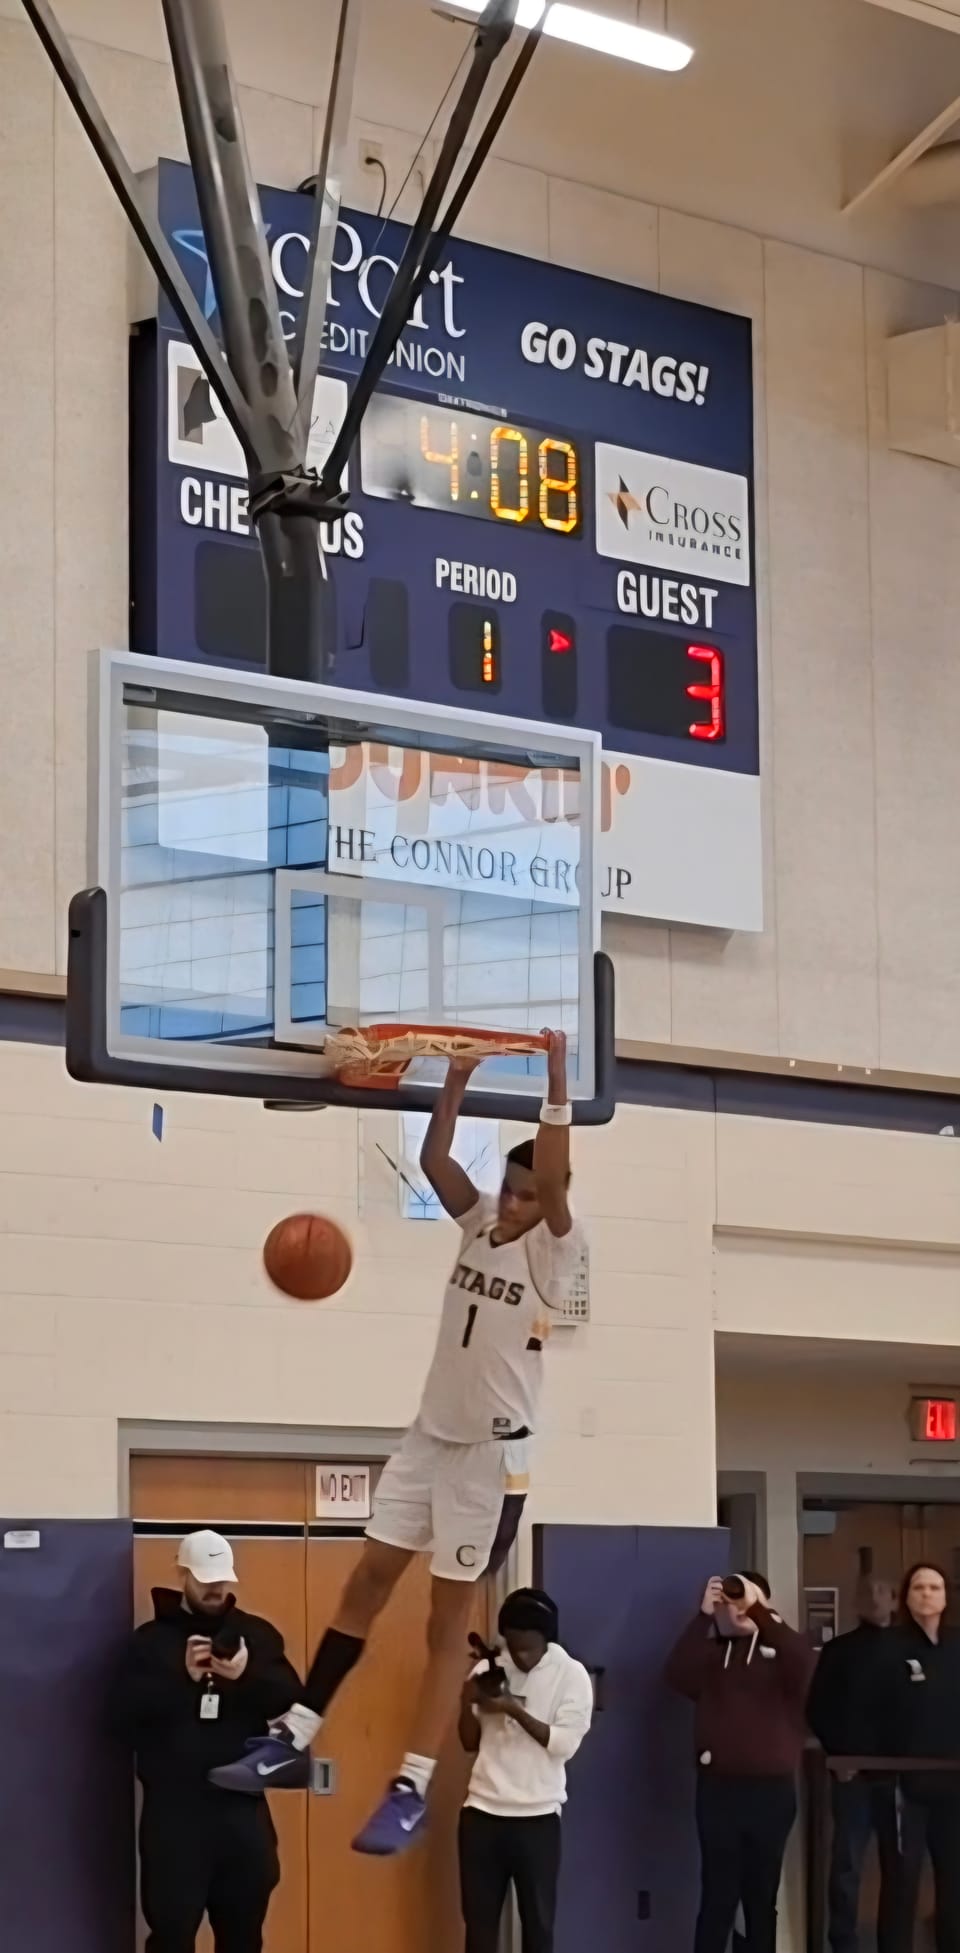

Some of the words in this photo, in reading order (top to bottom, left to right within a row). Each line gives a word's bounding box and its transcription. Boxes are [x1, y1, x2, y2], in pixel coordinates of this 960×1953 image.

[279, 311, 369, 358] CEDIT
[387, 338, 465, 382] NION
[521, 321, 577, 370] GO
[584, 337, 710, 405] STAGS!
[420, 416, 577, 533] 4:08
[180, 476, 365, 559] CHEUS
[435, 557, 517, 602] PERIOD
[617, 570, 719, 628] GUEST
[482, 620, 495, 682] 1
[686, 645, 724, 740] 3
[330, 825, 377, 862] HE
[390, 834, 518, 887] CONNOR
[530, 856, 632, 900] GRP
[462, 1303, 478, 1348] 1
[455, 1544, 477, 1568] C
